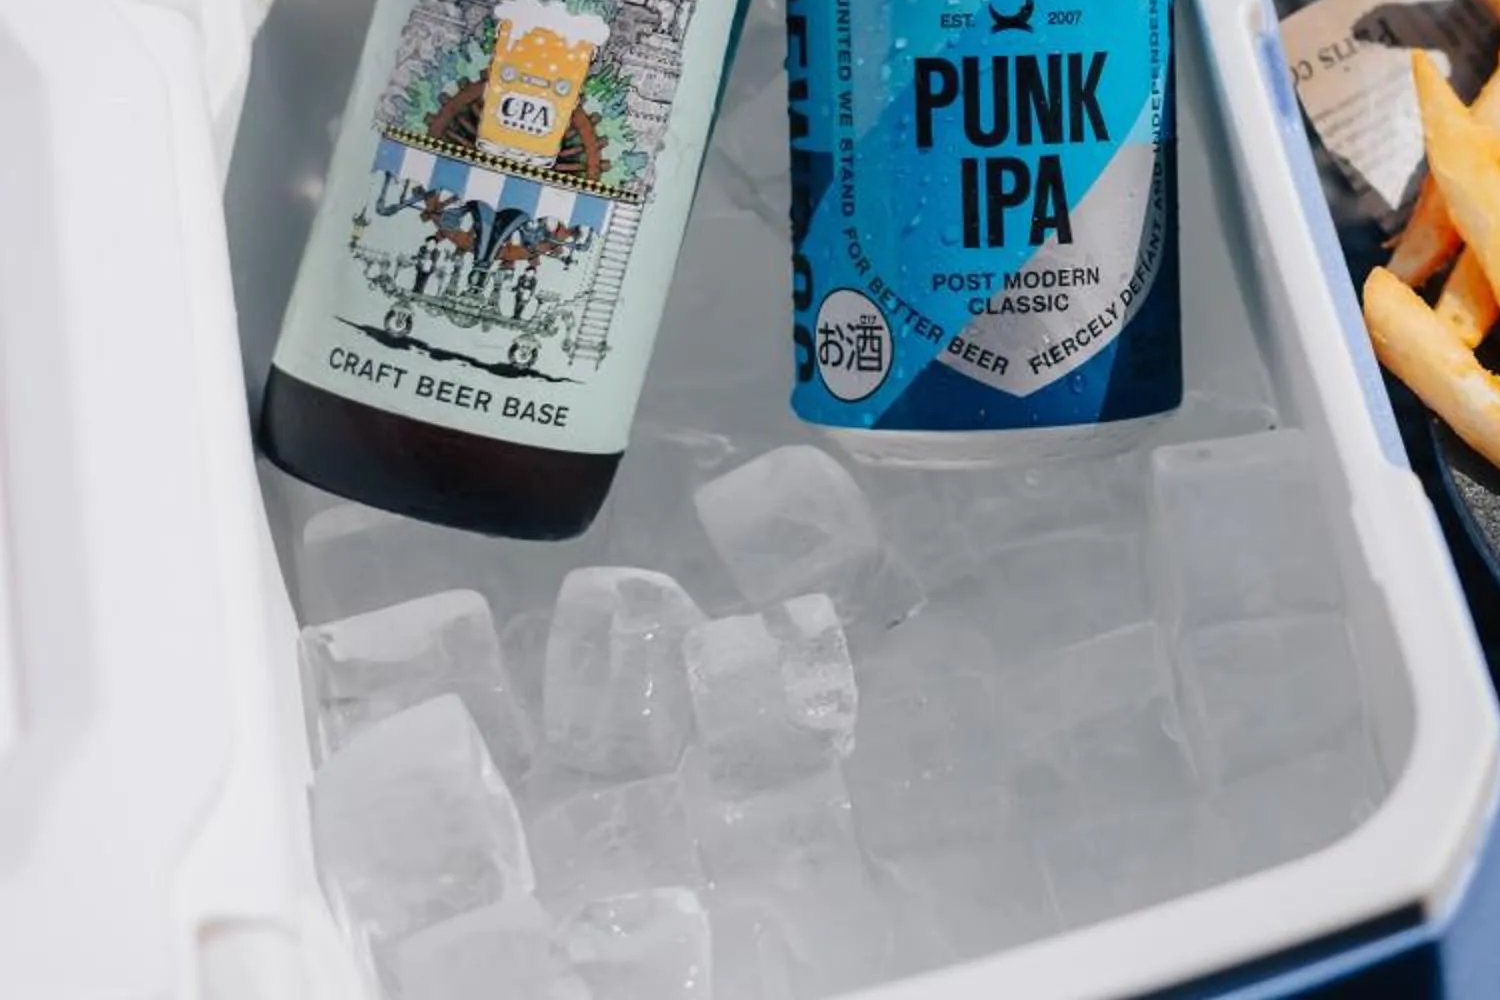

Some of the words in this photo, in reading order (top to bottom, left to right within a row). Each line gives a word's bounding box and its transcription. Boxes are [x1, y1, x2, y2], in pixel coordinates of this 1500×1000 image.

[940, 13, 976, 29] EST.
[1047, 10, 1082, 26] 2007
[502, 97, 549, 127] CPA
[838, 92, 853, 127] WE
[914, 52, 1110, 150] PUNK
[840, 138, 856, 218] STAND
[961, 154, 1073, 248] IPA
[842, 226, 872, 277] FOR
[932, 272, 996, 292] POST
[1003, 266, 1100, 290] MODERN
[868, 277, 945, 344] BETTER
[968, 293, 1069, 316] CLASSIC
[818, 322, 884, 372] お酒
[947, 336, 1010, 376] BEER
[1028, 302, 1122, 375] FIERCELY
[329, 347, 408, 389] CRAFT
[415, 375, 493, 413] BEER
[502, 396, 570, 427] BASE
